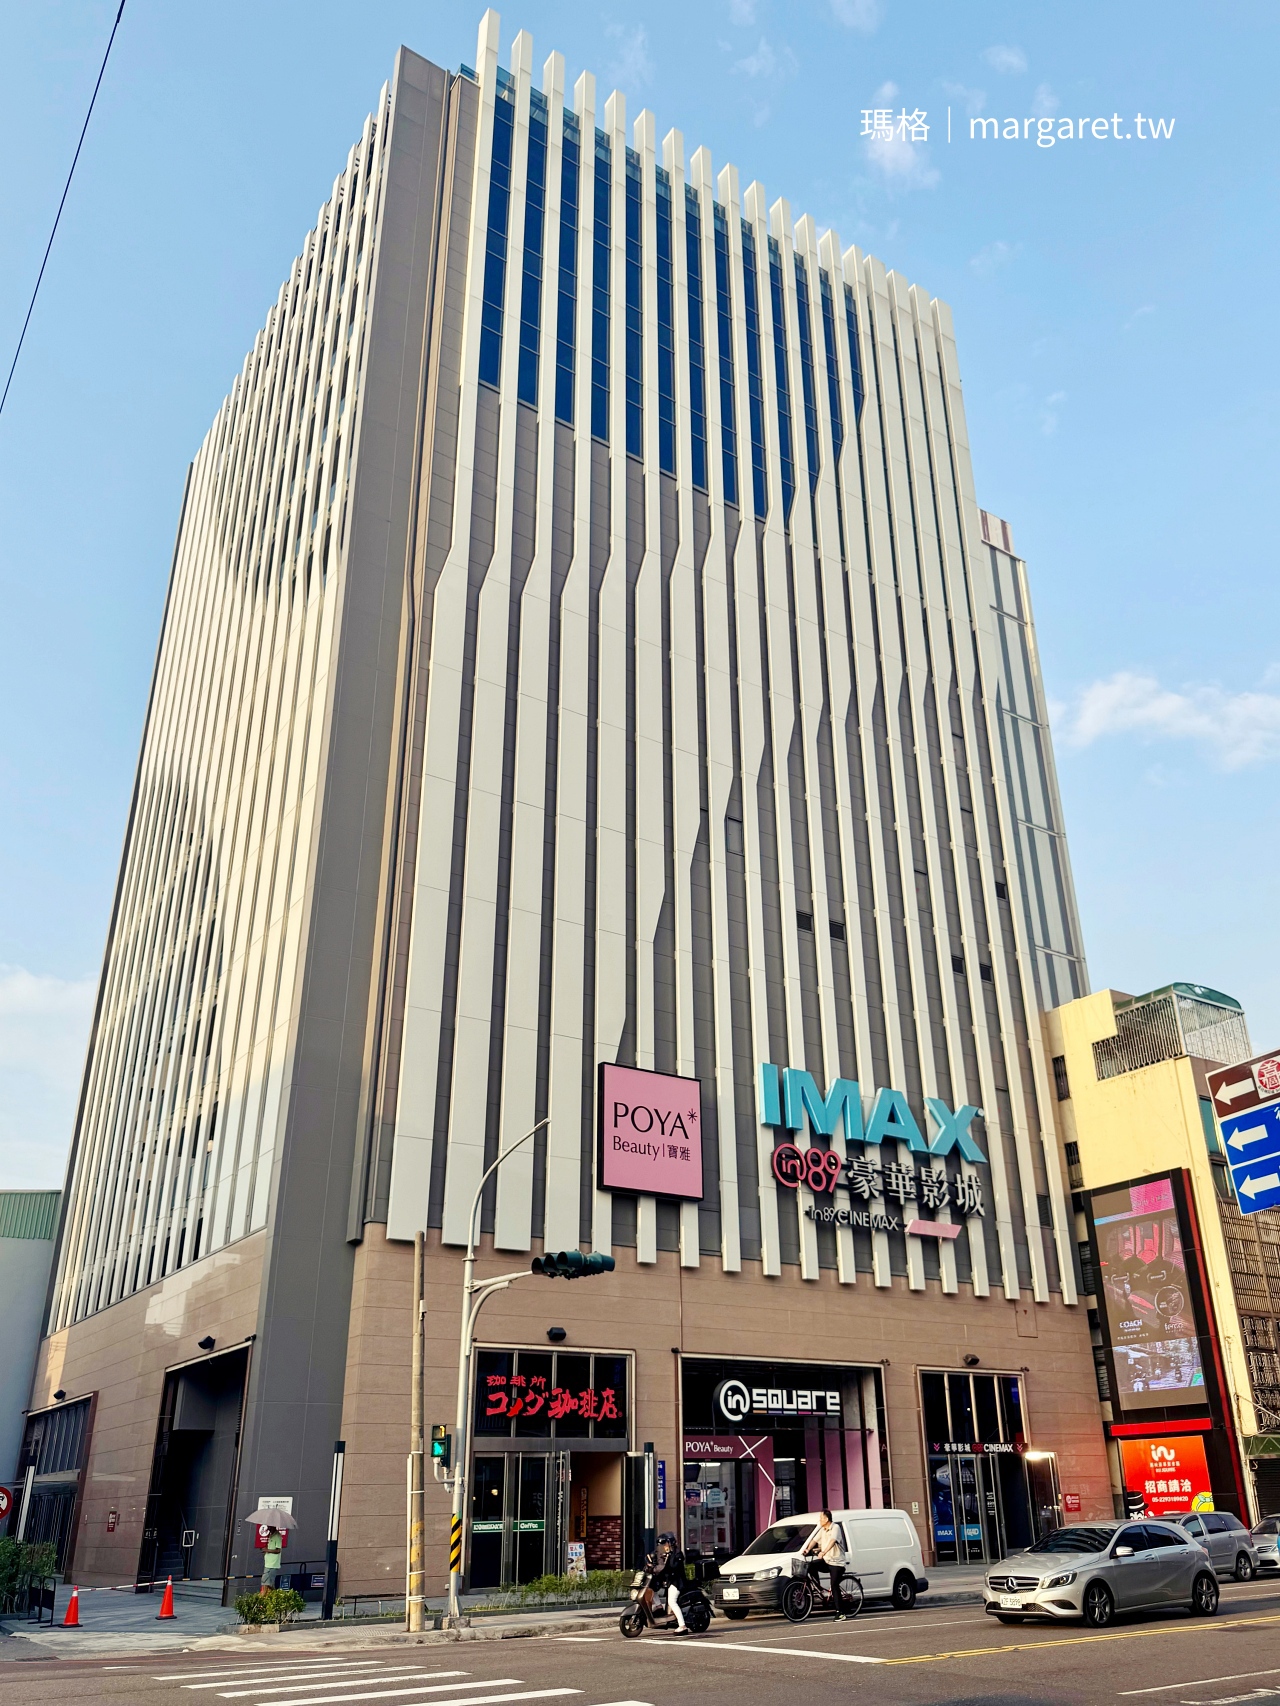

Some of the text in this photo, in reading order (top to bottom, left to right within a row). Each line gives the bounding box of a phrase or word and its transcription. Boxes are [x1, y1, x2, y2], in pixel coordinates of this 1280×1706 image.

[613, 1102, 690, 1140] POYA
[758, 1062, 988, 1164] IMAX
[613, 1135, 691, 1162] Beauty 寶雅
[847, 1156, 986, 1217] 豪華影城
[685, 1441, 734, 1455] POYA Beauty
[983, 1443, 1014, 1453] CINEMAX
[1144, 1478, 1192, 1494] 招商請洽
